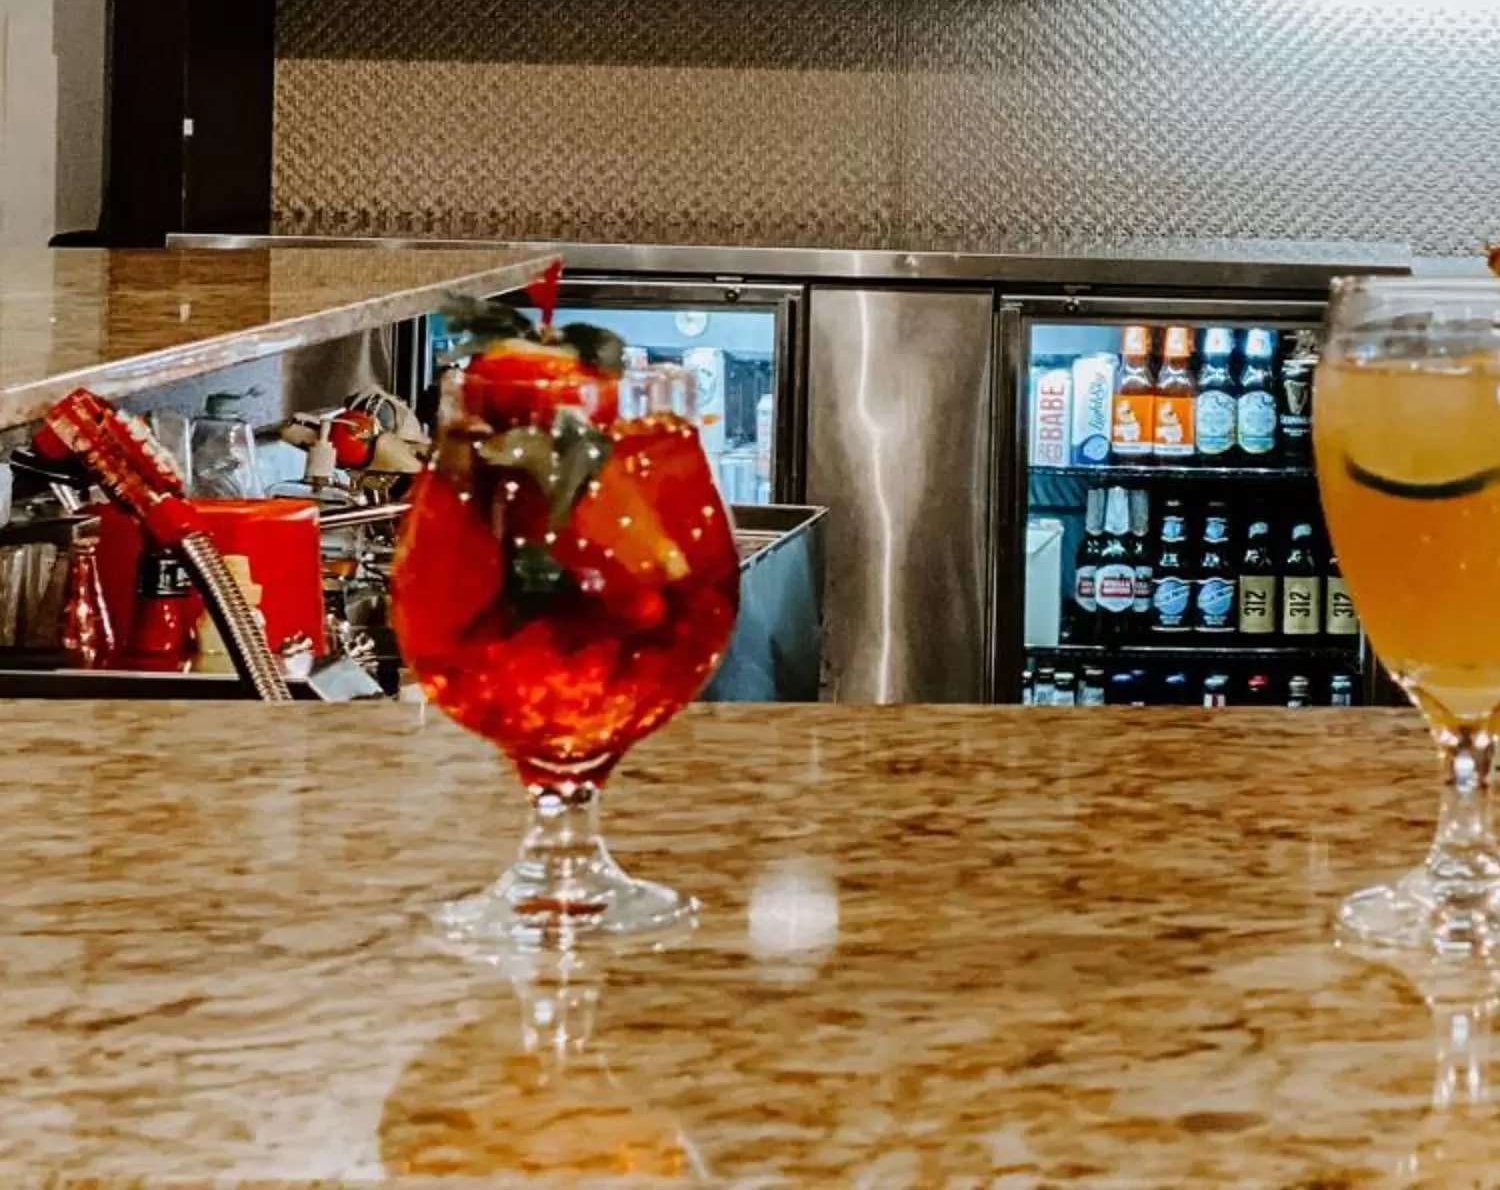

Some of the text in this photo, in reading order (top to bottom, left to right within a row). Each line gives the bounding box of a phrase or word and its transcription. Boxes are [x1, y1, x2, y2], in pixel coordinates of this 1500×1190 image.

[1040, 385, 1064, 440] BABE
[1244, 591, 1266, 617] 312
[1289, 591, 1311, 617] 312
